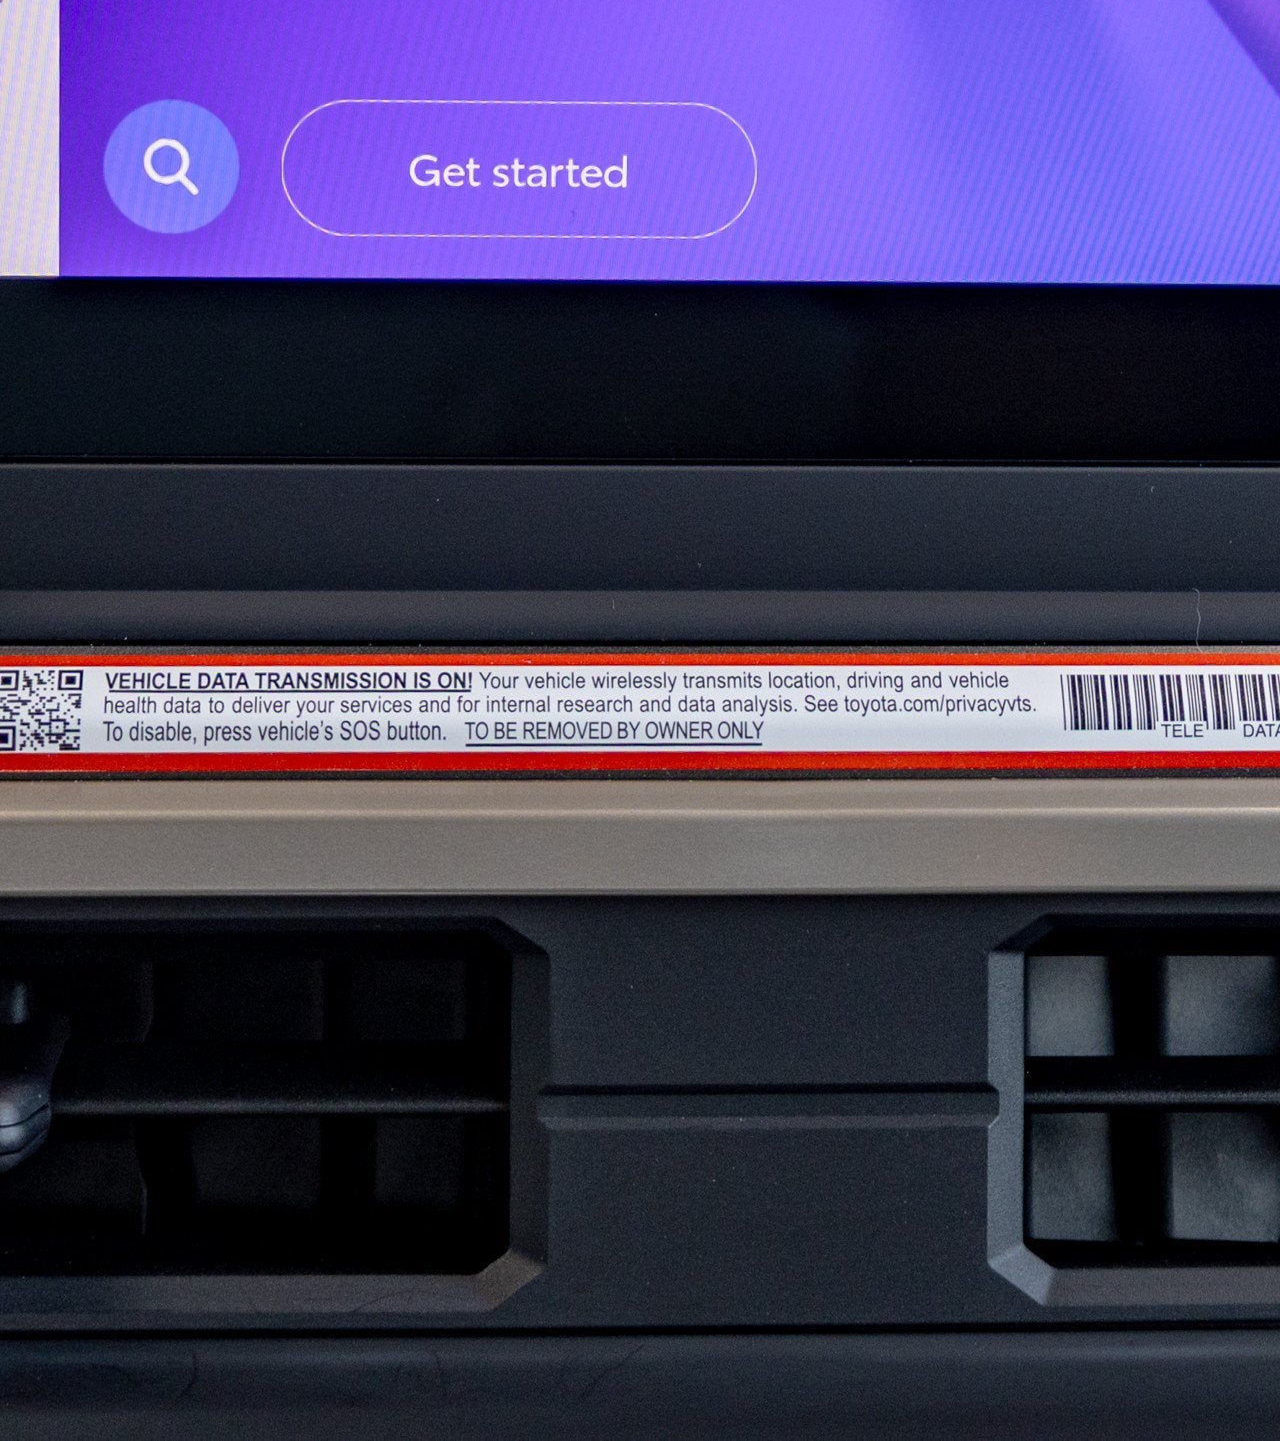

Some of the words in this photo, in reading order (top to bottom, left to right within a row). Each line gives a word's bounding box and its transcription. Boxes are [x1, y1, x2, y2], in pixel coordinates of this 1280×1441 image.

[409, 155, 480, 188] Get
[492, 155, 628, 189] started
[105, 672, 192, 689] VEHICLE
[198, 672, 249, 689] DATA
[255, 672, 407, 689] TRANSMISSION
[414, 672, 431, 689] IS
[437, 672, 472, 689] ON!
[479, 672, 519, 689] Your
[525, 672, 585, 689] vehicle
[591, 672, 677, 692] wirelessly
[683, 672, 762, 689] transmits
[768, 672, 841, 691] location,
[847, 672, 904, 692] driving
[911, 672, 942, 689] and
[949, 671, 1009, 688] vehicle
[104, 696, 157, 714] health
[163, 696, 201, 714] data
[208, 697, 225, 714] to
[232, 696, 290, 714] deliver
[296, 699, 335, 718] your
[340, 696, 412, 713] services
[418, 696, 451, 713] and
[456, 696, 480, 713] for
[486, 696, 551, 713] internal
[557, 696, 632, 712] research
[639, 695, 671, 712] and
[678, 695, 715, 712] data
[722, 695, 798, 716] analysis.
[804, 694, 838, 712] See
[844, 694, 1037, 716] toyota.com/privacyvts.
[103, 721, 123, 741] To
[129, 721, 197, 744] disable,
[204, 724, 252, 746] press
[340, 720, 381, 741] SOS
[388, 720, 447, 740] button.
[465, 721, 489, 740] TO
[494, 721, 517, 740] BE
[523, 721, 612, 740] REMOVED
[618, 721, 641, 739] BY
[645, 721, 713, 739] OWNER
[717, 721, 764, 739] ONLY
[1161, 723, 1204, 738] TELE
